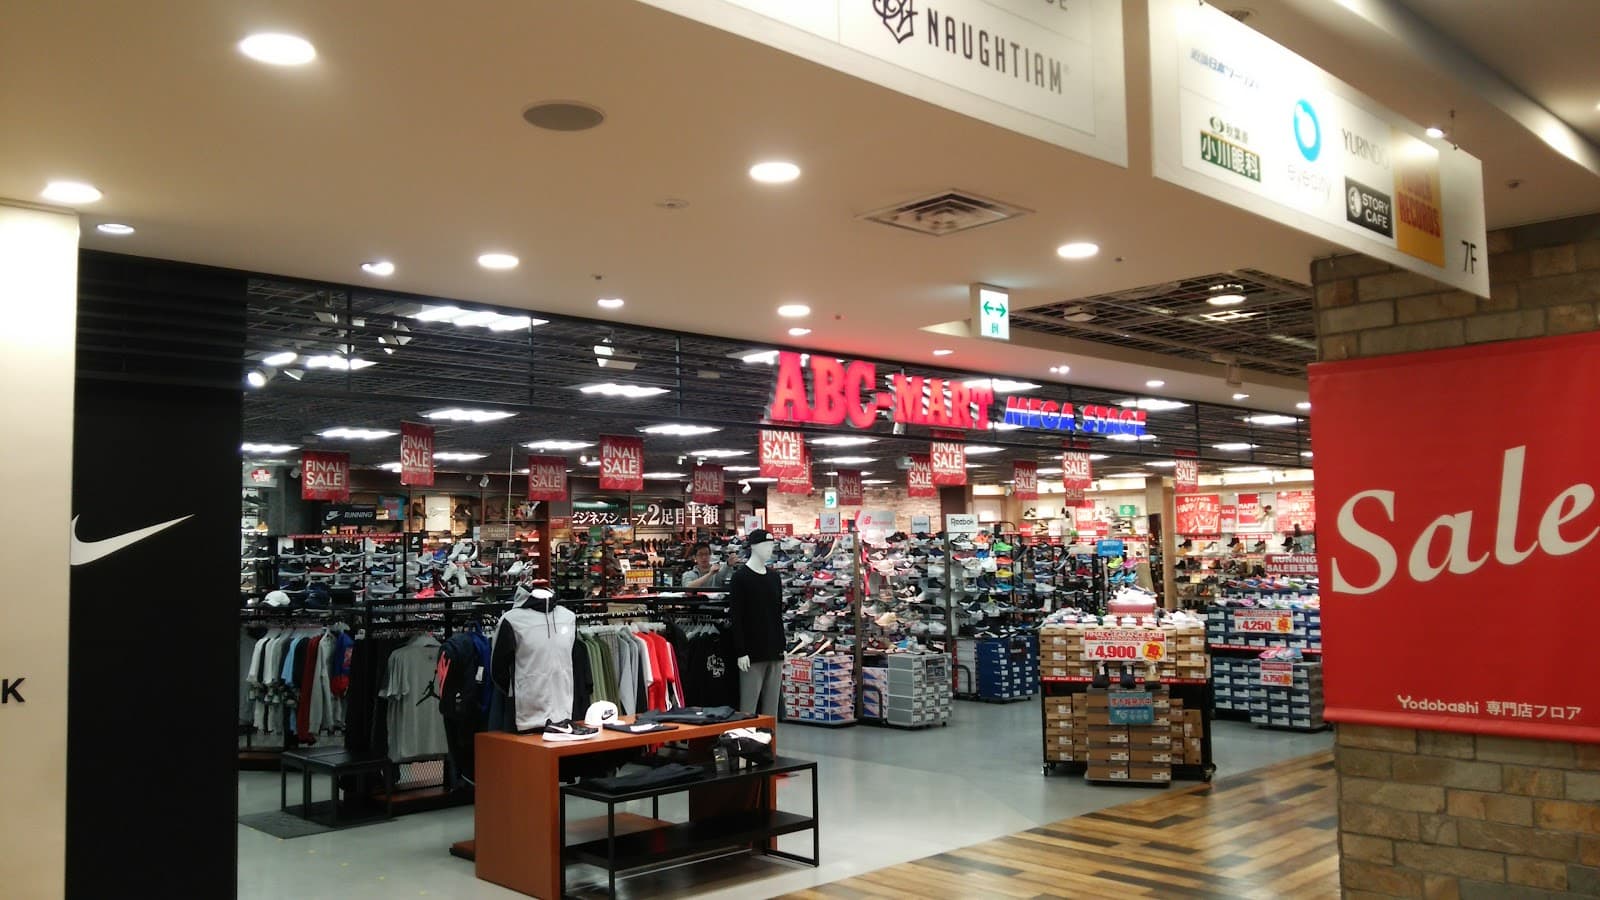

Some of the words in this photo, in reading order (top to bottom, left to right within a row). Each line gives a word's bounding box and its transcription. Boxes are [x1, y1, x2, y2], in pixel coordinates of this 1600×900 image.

[927, 7, 1062, 95] NAUGHTIAM
[1201, 135, 1259, 180] 小川眼科
[1361, 192, 1390, 213] STORY
[1364, 208, 1389, 228] CAFE
[1461, 240, 1478, 274] 7F
[769, 349, 994, 430] ABC-MART
[1004, 395, 1076, 431] MEGA
[1082, 403, 1147, 437] STAGE
[402, 435, 428, 449] FINAL
[932, 442, 960, 454] FINAL
[602, 445, 635, 459] FINAL
[762, 442, 797, 460] SALE
[402, 449, 429, 468] SALE
[933, 453, 961, 469] SALE
[305, 460, 342, 473] FINAL
[530, 464, 561, 474] FINAL
[603, 458, 637, 474] SALE
[1064, 461, 1087, 475] SALE
[305, 472, 342, 486] SALE
[531, 474, 561, 488] SALE
[909, 471, 931, 485] SALE
[1176, 468, 1195, 481] SALE
[694, 480, 719, 493] SALE
[1015, 477, 1035, 489] SALE
[1066, 488, 1083, 498] SALE
[1331, 445, 1600, 595] Sale
[1272, 555, 1317, 563] RUNNING
[1095, 645, 1137, 659] 4,900
[1397, 694, 1479, 714] Yodobashi
[1485, 700, 1582, 720] 専門店フロア
